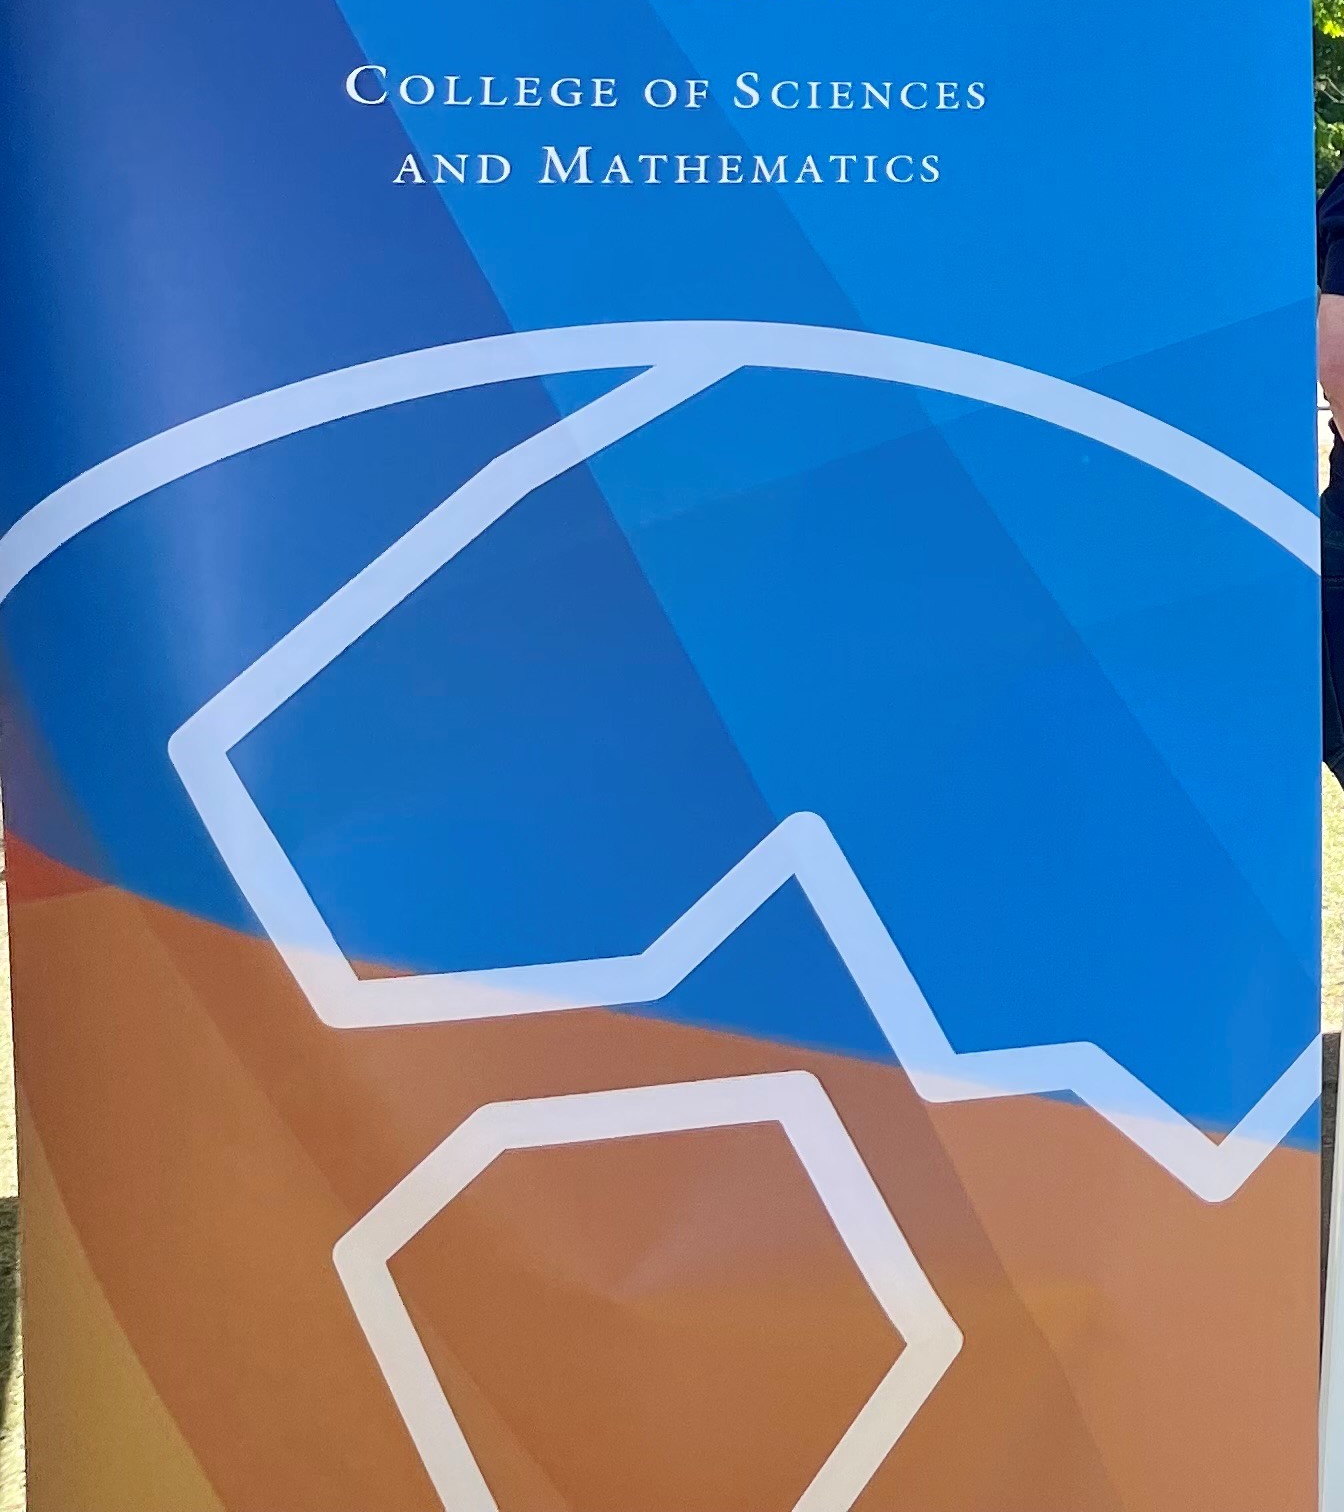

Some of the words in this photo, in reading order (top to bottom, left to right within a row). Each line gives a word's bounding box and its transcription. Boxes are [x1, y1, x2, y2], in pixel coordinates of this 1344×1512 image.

[345, 65, 618, 107] COLLEGE
[644, 79, 709, 108] OF
[734, 72, 987, 110] SCIENCES
[392, 153, 512, 184] AND
[539, 146, 942, 185] MATHEMATICS
